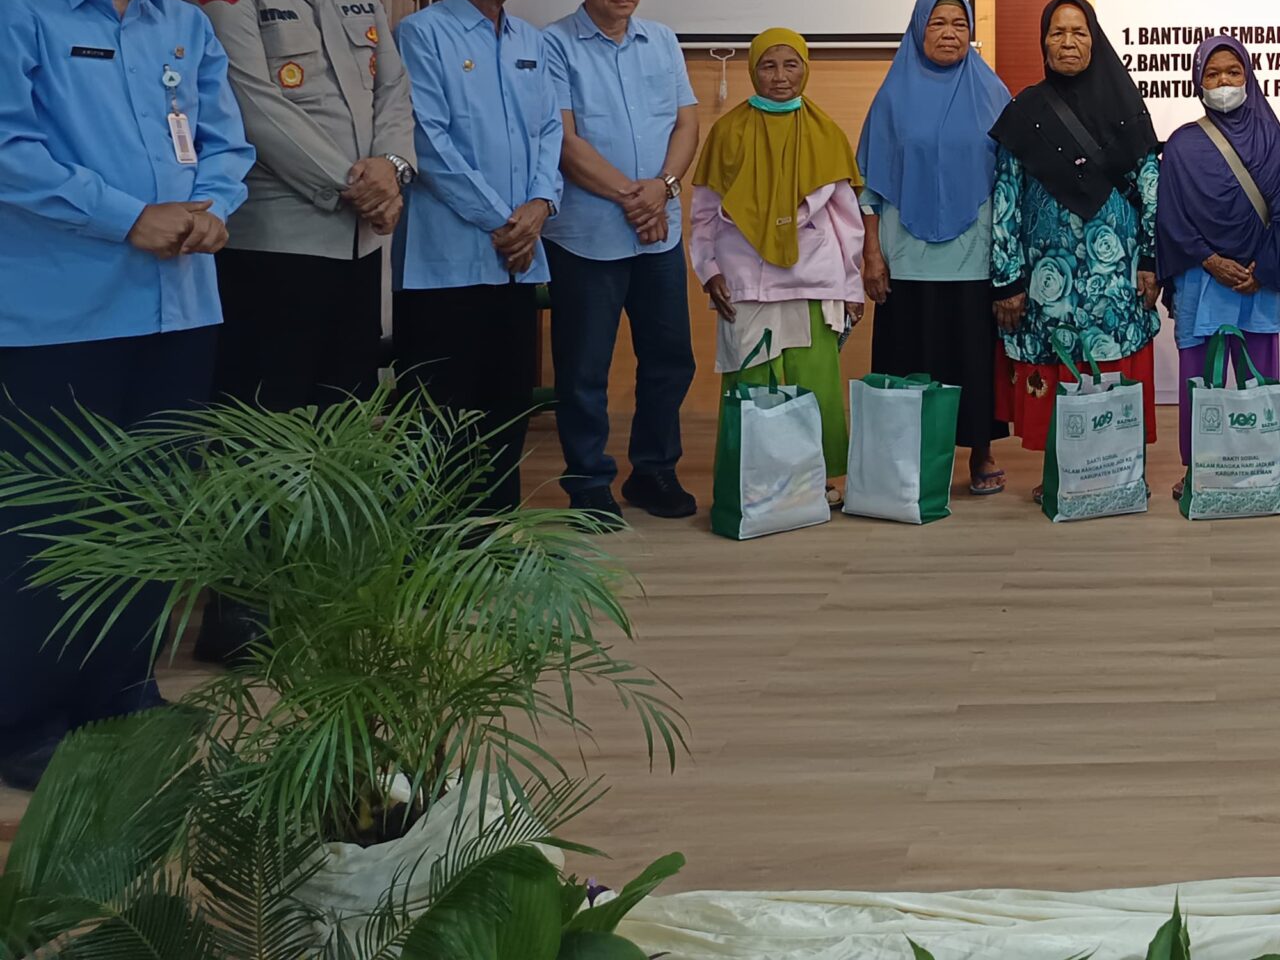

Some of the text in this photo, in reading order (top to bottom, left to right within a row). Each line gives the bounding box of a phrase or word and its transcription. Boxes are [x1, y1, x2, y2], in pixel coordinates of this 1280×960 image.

[1122, 27, 1134, 45] 1.
[1139, 27, 1215, 45] BANTUAN
[1122, 53, 1191, 72] 2.BANTU
[1138, 80, 1201, 98] BANTU
[1228, 412, 1257, 427] 109
